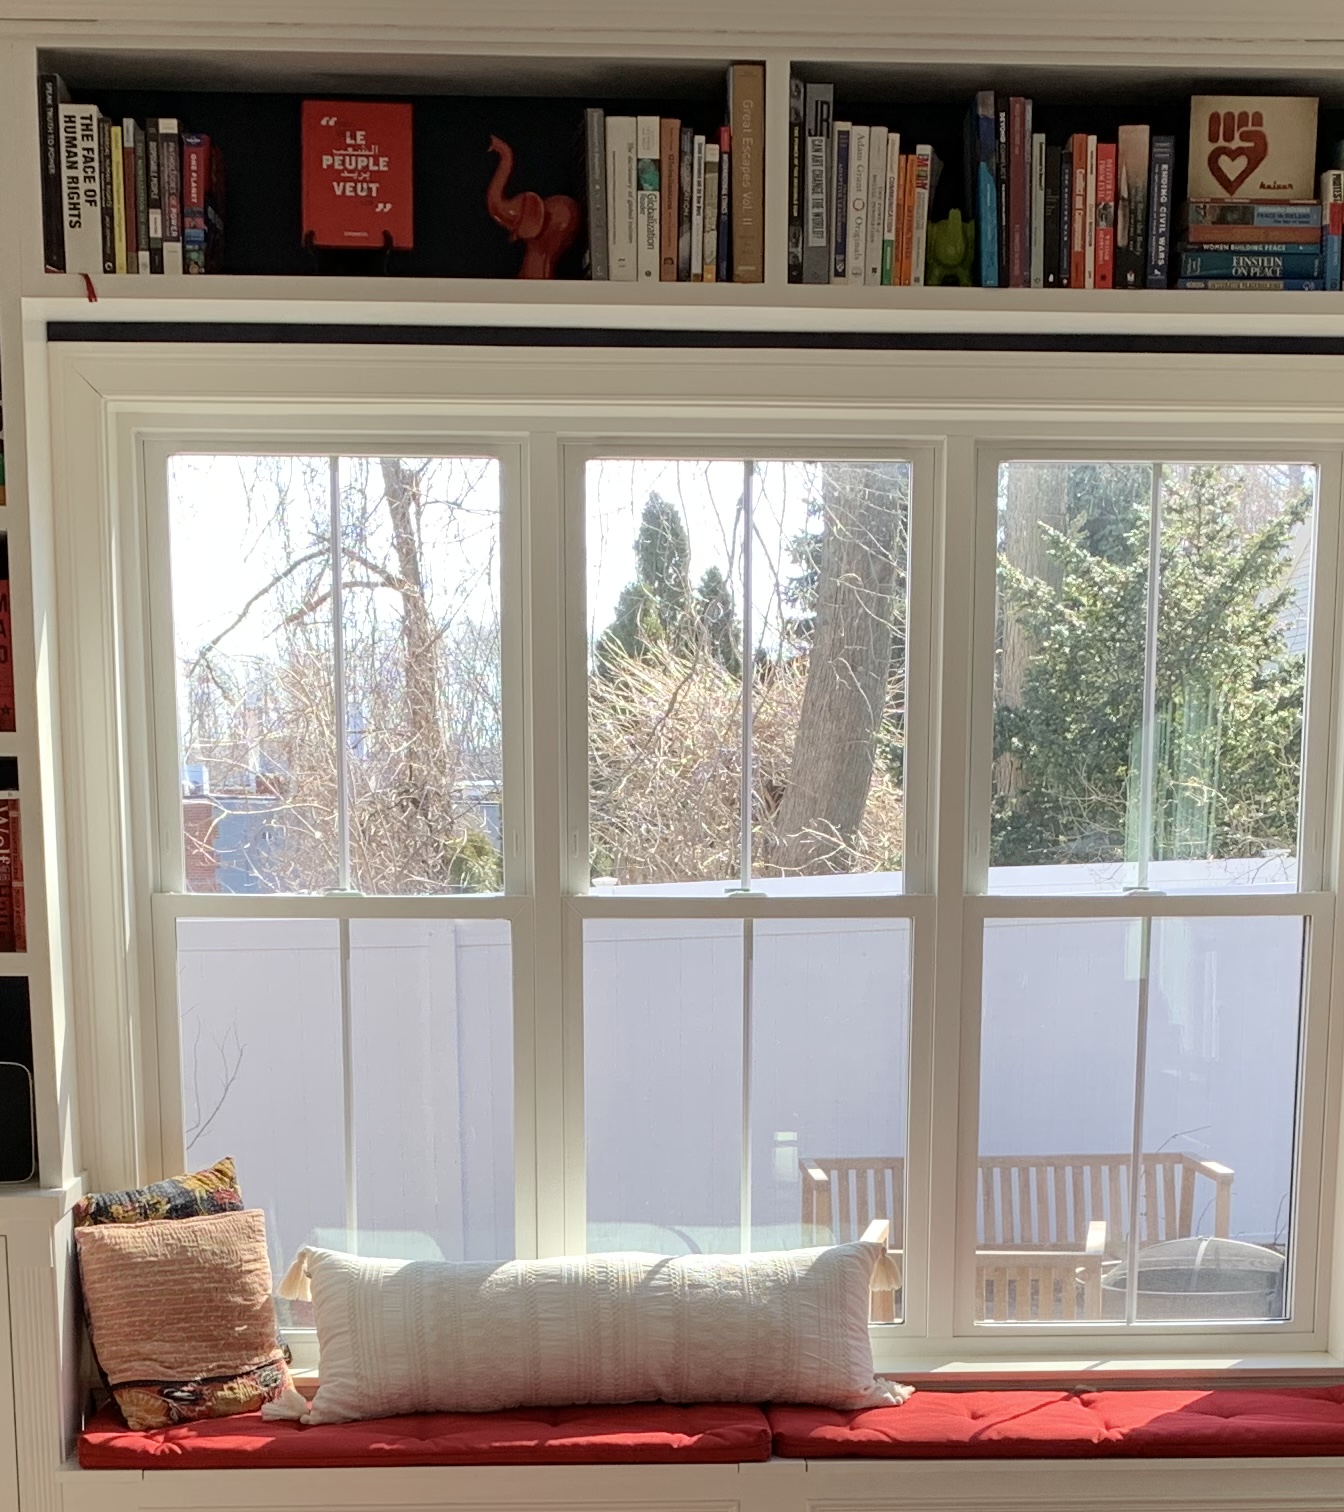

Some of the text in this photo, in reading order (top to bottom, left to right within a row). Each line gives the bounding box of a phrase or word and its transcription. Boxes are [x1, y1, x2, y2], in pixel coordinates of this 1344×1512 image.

[45, 82, 56, 174] SPEAK TRUTH TO POWER
[743, 99, 753, 132] Great
[346, 131, 366, 144] LE
[64, 115, 81, 229] HUMAN RIGHTS
[80, 115, 97, 207] THE FACE OF
[322, 155, 389, 171] PEUPLE
[742, 137, 753, 187] Escapes
[856, 133, 864, 192] Adam Grant
[190, 172, 198, 203] PLANET
[333, 182, 380, 197] VEUT
[743, 191, 753, 212] Vol.
[811, 139, 824, 239] CAN ART CHANGE THE WORLD?
[170, 208, 178, 237] POWER
[646, 193, 657, 249] Globalization
[1158, 164, 1168, 266] ENDING CIVIL WARS
[854, 217, 863, 260] Originals
[1232, 256, 1282, 266] EINSTEIN
[1232, 266, 1282, 277] ON PEACE
